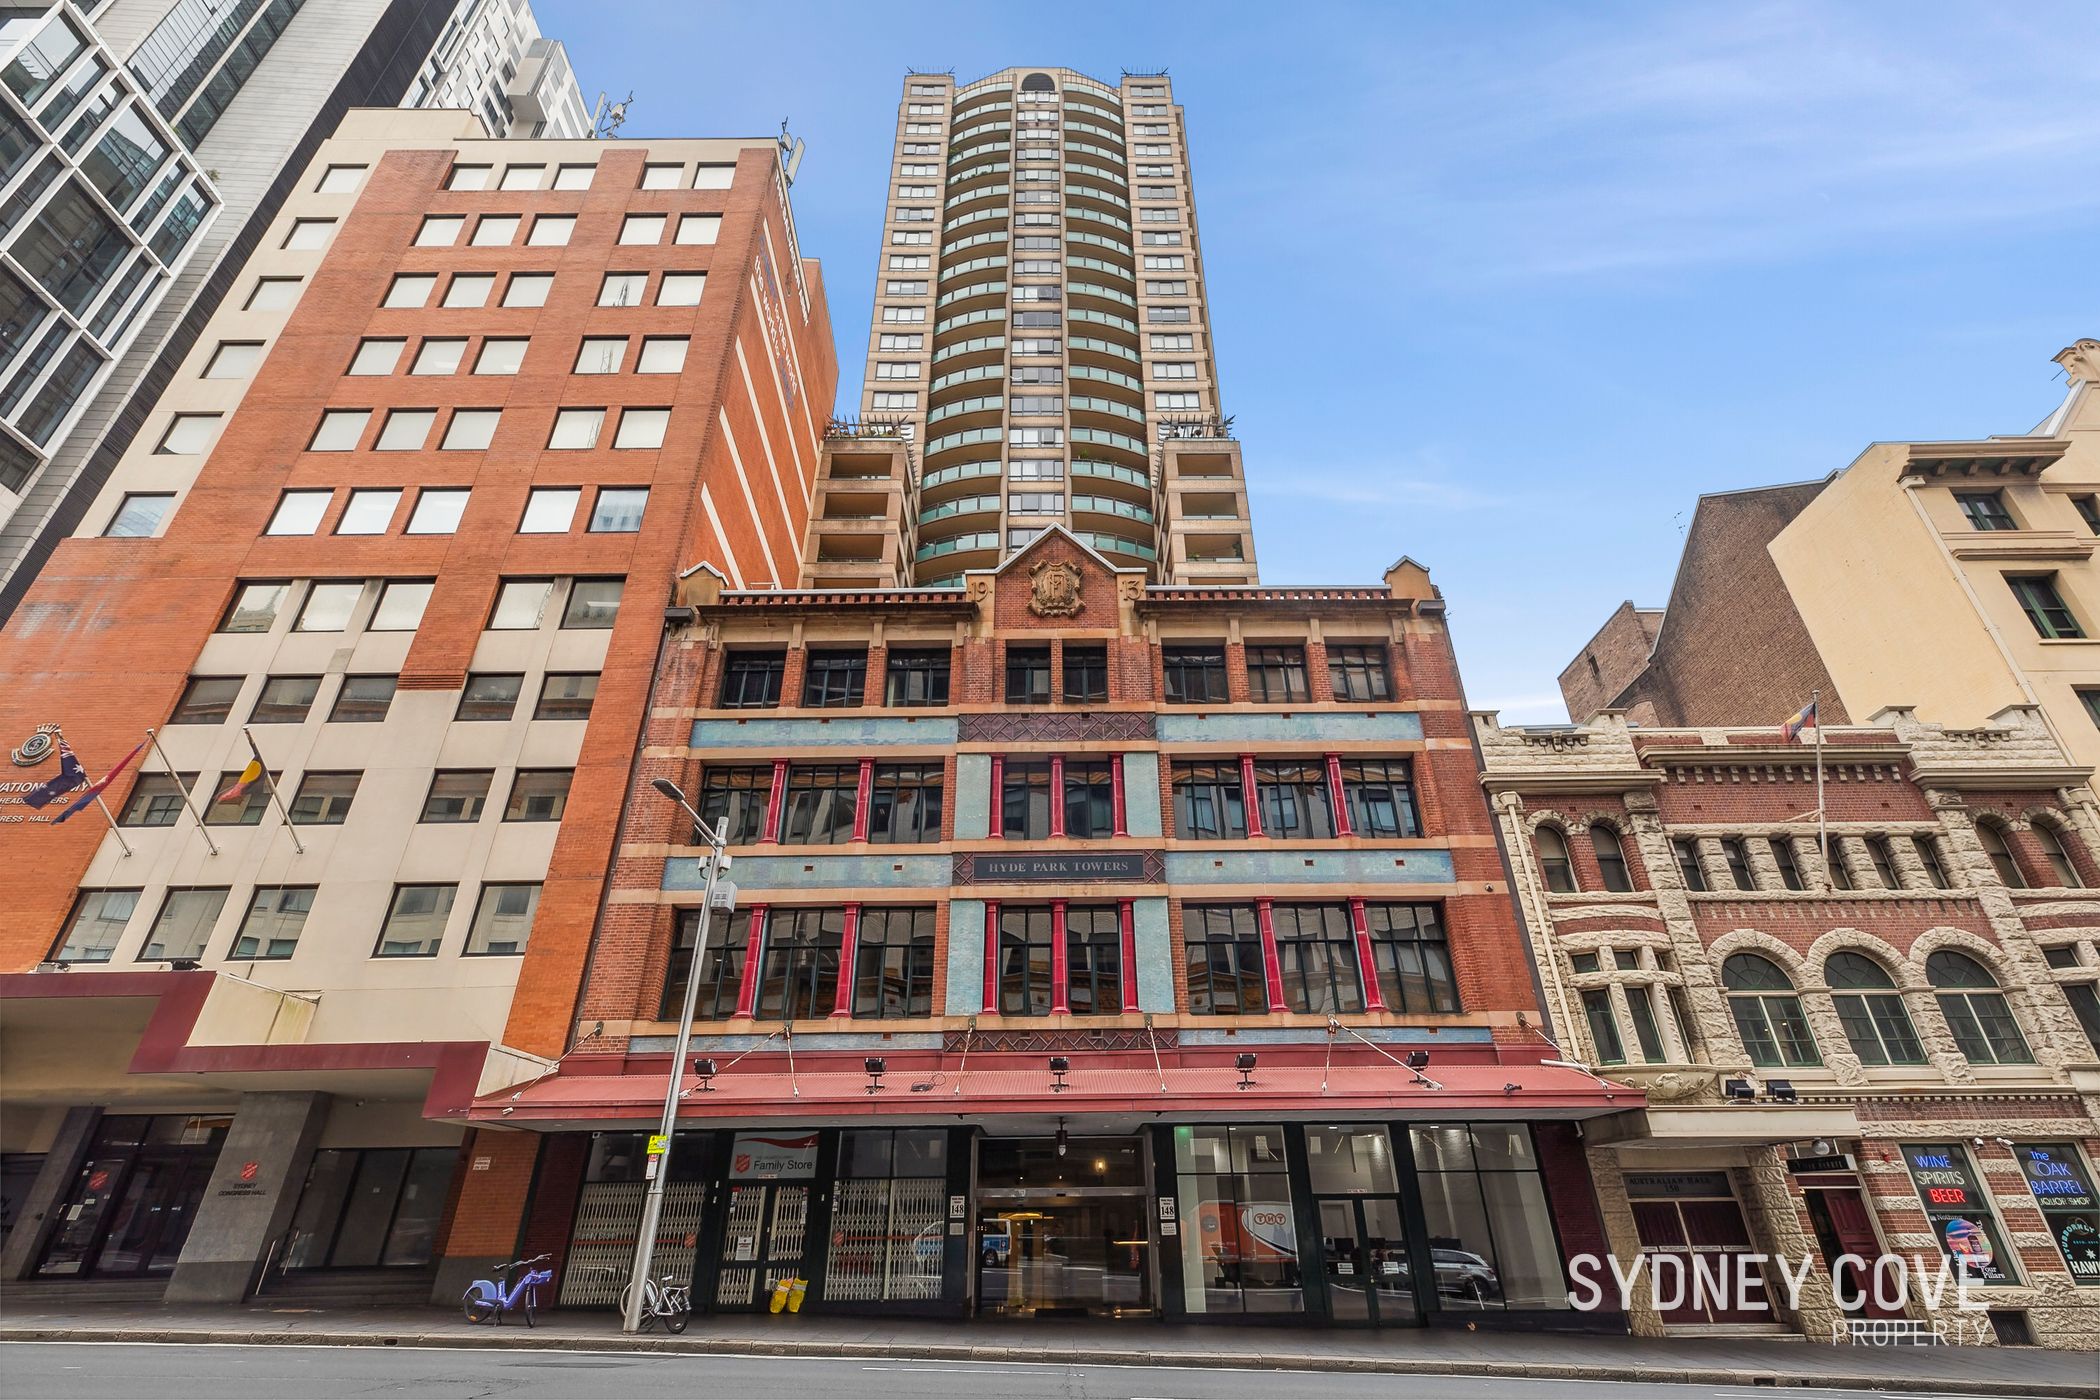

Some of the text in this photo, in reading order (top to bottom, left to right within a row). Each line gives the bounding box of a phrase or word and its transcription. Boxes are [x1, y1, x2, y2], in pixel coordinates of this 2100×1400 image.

[775, 167, 809, 328] THE SALVATION ARMY
[755, 255, 764, 292] the
[763, 291, 777, 343] world
[779, 319, 787, 352] the
[786, 348, 798, 396] world
[972, 581, 989, 601] 19
[1122, 580, 1142, 600] 13
[989, 861, 1129, 873] HYDE PARK TOWERS
[753, 1161, 785, 1172] Family
[787, 1160, 813, 1170] Store
[1914, 1155, 1952, 1168] WINE
[2037, 1161, 2072, 1176] OAK
[1629, 1176, 1713, 1185] AUSTRALIAN HALL
[1917, 1170, 1965, 1185] SPIRITS
[2031, 1180, 2086, 1195] BARREL
[1929, 1188, 1966, 1203] BEER
[2067, 1197, 2091, 1206] SHOP
[951, 1204, 964, 1214] 148
[1161, 1206, 1175, 1216] 148
[2061, 1223, 2096, 1261] STUBBORNLY
